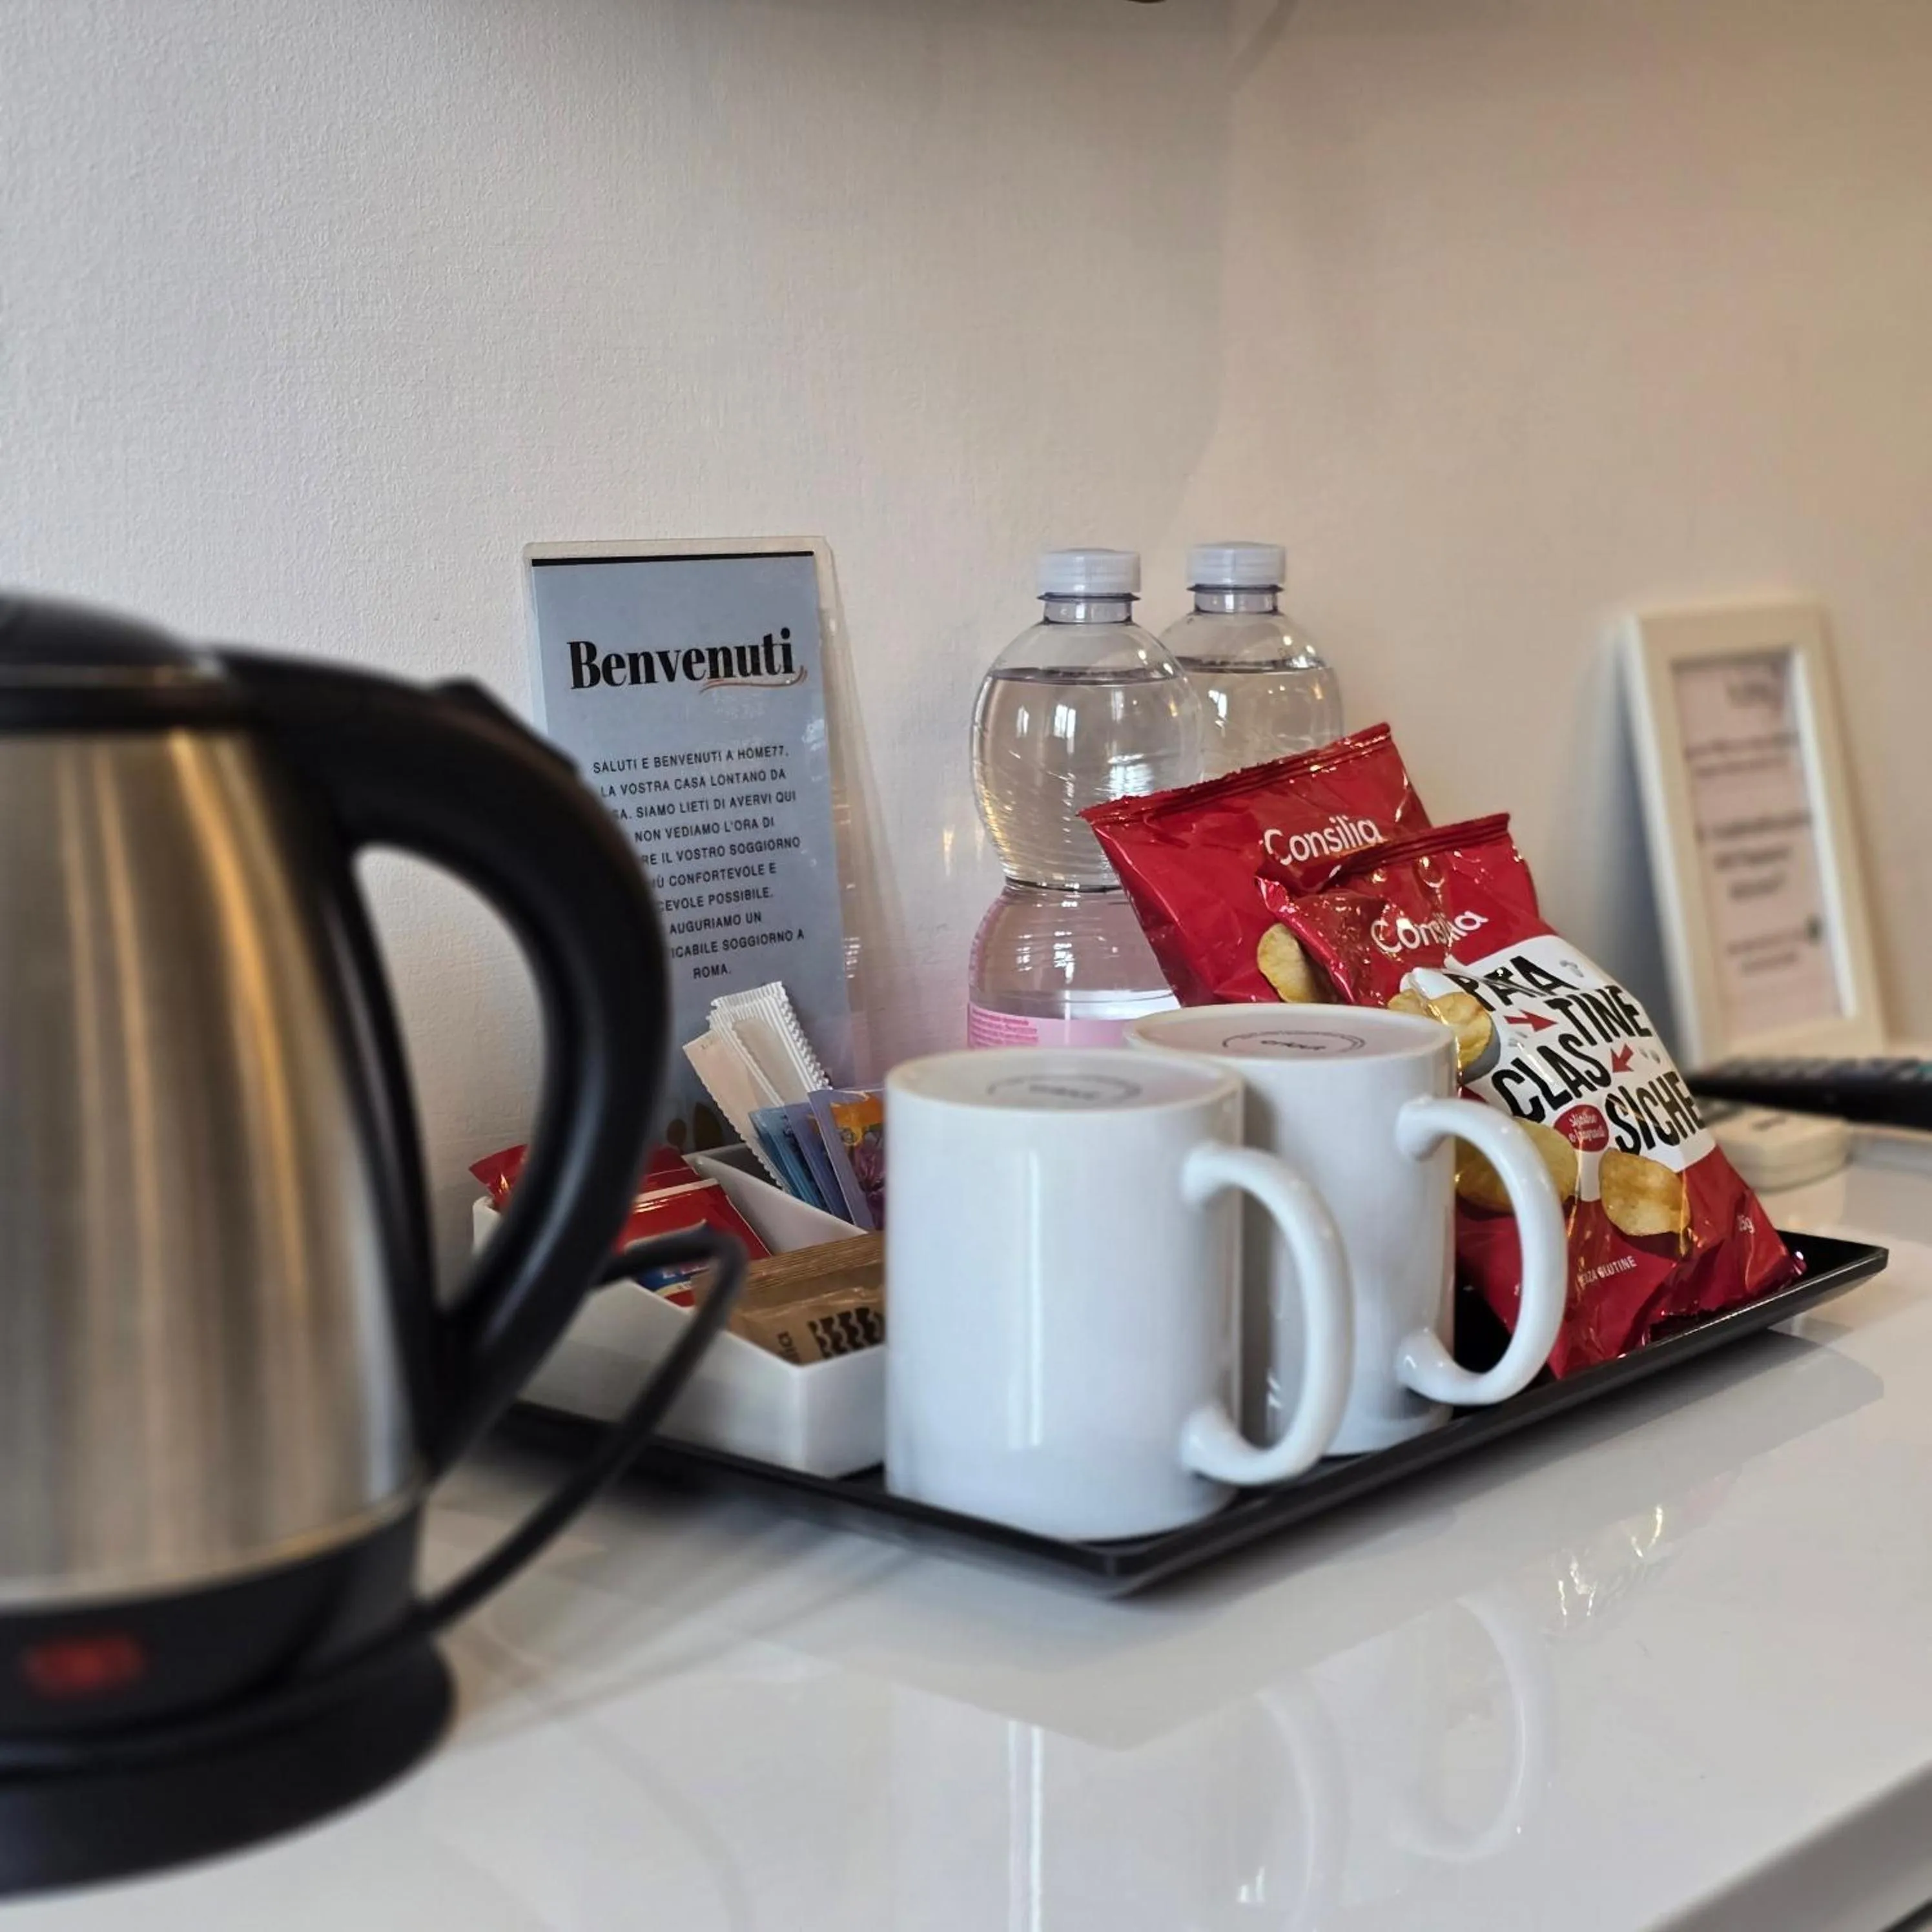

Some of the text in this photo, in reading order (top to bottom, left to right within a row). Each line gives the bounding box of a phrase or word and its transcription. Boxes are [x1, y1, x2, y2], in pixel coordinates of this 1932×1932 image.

[566, 627, 796, 690] Benvenuti
[593, 757, 637, 774] SALUTI
[642, 757, 649, 770] E
[654, 750, 723, 768] BENVENUTI
[726, 749, 734, 761] A
[601, 768, 787, 798] LA VOSTRA CASA LONTANO DA
[636, 803, 675, 819] SIAMO
[679, 799, 710, 814] LIETI
[714, 797, 726, 810] DI
[729, 792, 772, 808] AVERVI
[776, 790, 797, 803] QUI
[634, 816, 774, 843] NON VEDIAMO L'ORA DI
[1264, 814, 1388, 865] Consilia
[661, 852, 673, 864] IL
[675, 846, 726, 862] VOSTRO
[729, 836, 801, 856] SOGGIORNO
[668, 862, 765, 888] CONFORTEVOLE
[768, 861, 777, 874] E
[708, 886, 774, 906] POSSIBILE.
[669, 911, 763, 935] AUGURIAMO UN
[1370, 910, 1489, 954] Consilia
[671, 928, 805, 959] ICABILE SOGGIORNO A
[692, 963, 732, 979] ROMA.
[1544, 985, 1652, 1047] TINE
[1491, 1032, 1612, 1125] CLAS
[1605, 1071, 1707, 1156] SICHE
[1596, 1255, 1638, 1279] GLUTINE
